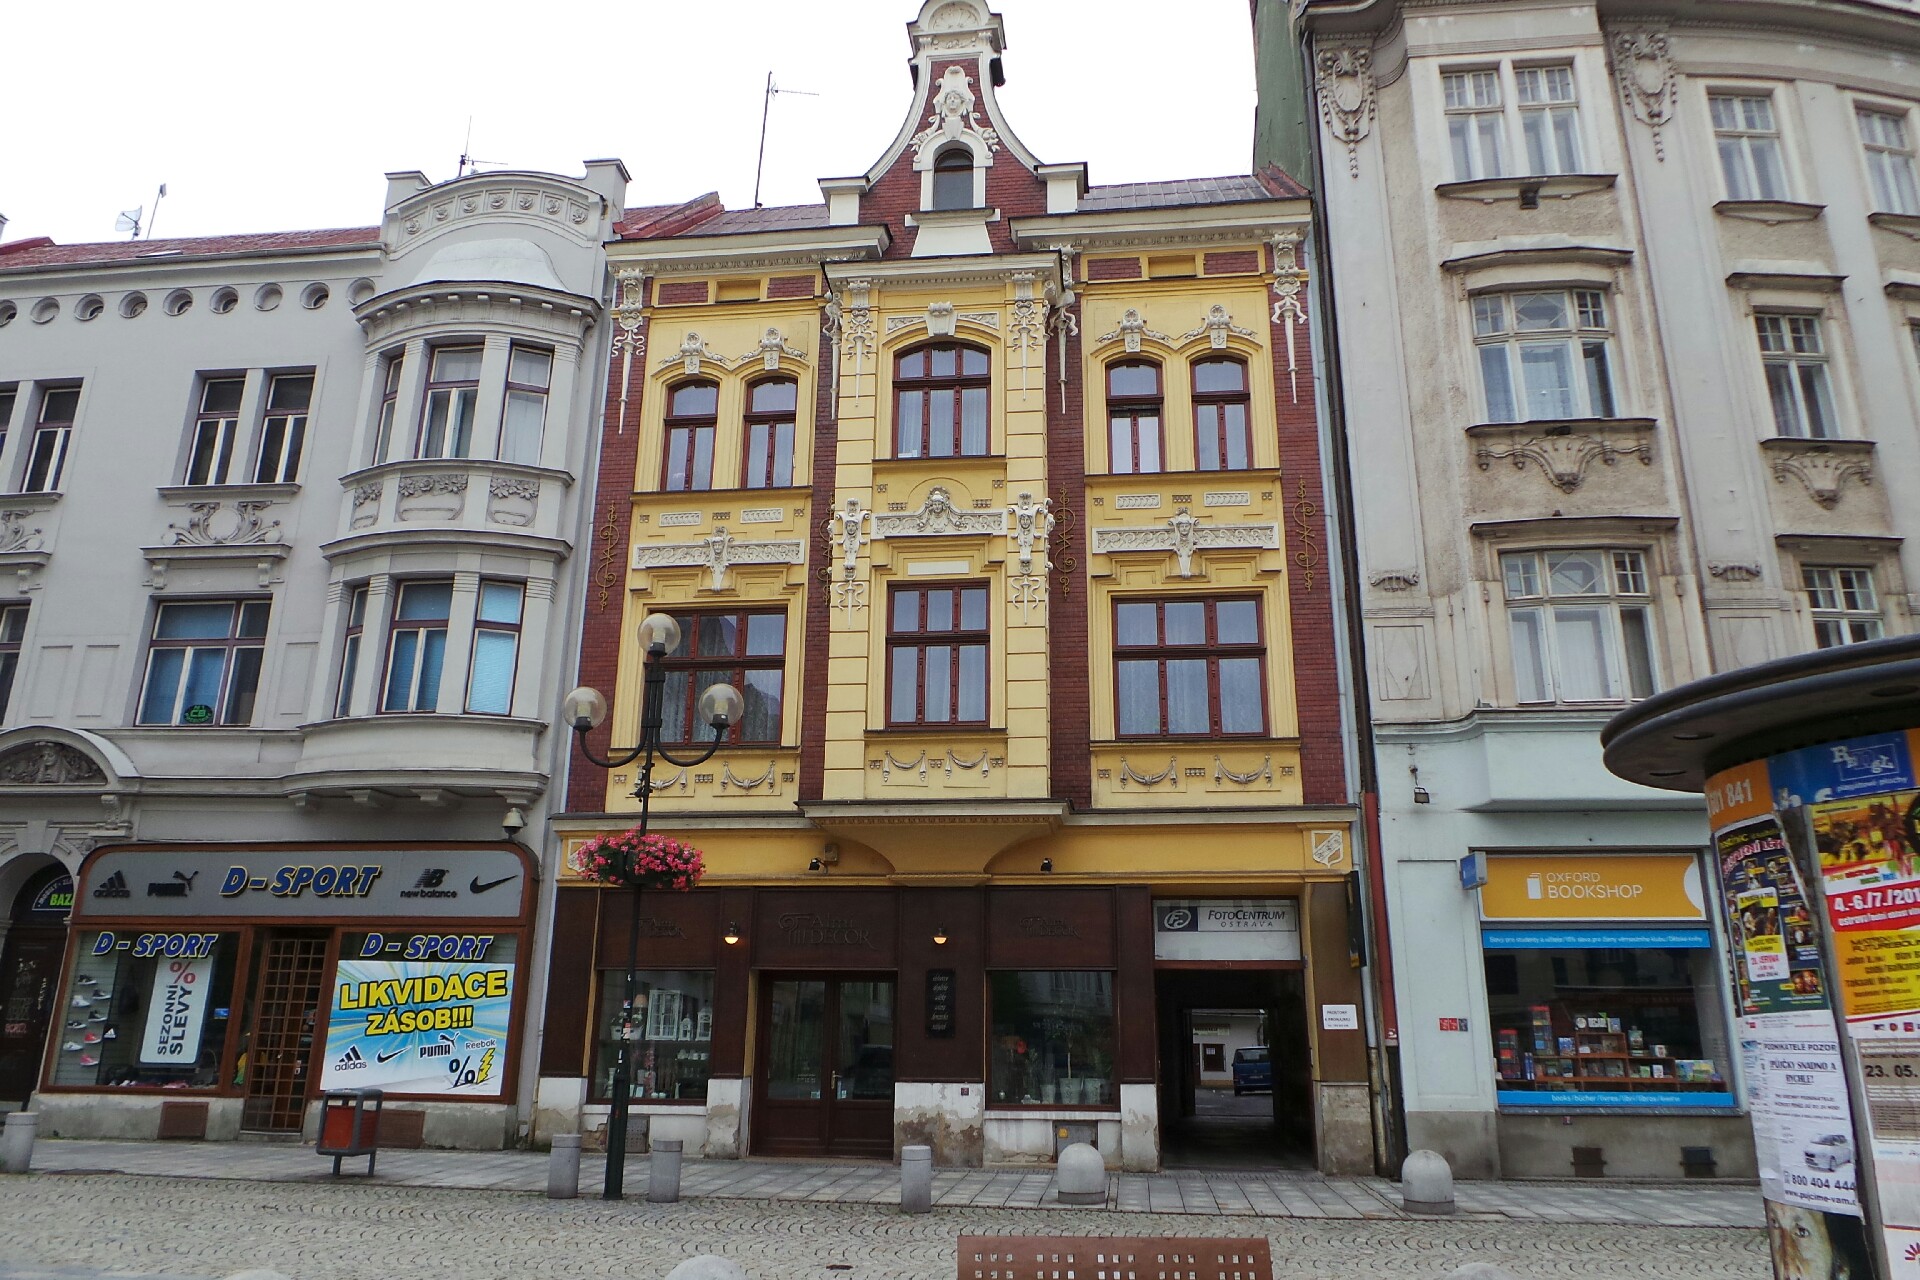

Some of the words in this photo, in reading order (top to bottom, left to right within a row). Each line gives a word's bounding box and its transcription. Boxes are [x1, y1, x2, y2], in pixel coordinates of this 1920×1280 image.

[1726, 779, 1753, 807] 841
[1546, 873, 1601, 882] OXFORD
[420, 890, 457, 899] balance
[1548, 884, 1643, 899] BOOKSHOP
[50, 894, 74, 906] BAZ
[339, 970, 508, 1010] LIKVIDACE
[157, 984, 179, 1055] SEZONNÍ
[169, 986, 193, 1055] SLEVY
[365, 1006, 474, 1037] ZÁSOB!!!
[419, 1044, 451, 1058] PUMA
[465, 1038, 496, 1050] Reebok
[1808, 1043, 1838, 1051] POZOR
[334, 1059, 367, 1072] adidas
[1864, 1065, 1889, 1077] 23.
[1894, 1065, 1918, 1077] 05.
[1792, 1175, 1808, 1186] 800
[1810, 1177, 1830, 1188] 404
[1834, 1180, 1857, 1191] 444
